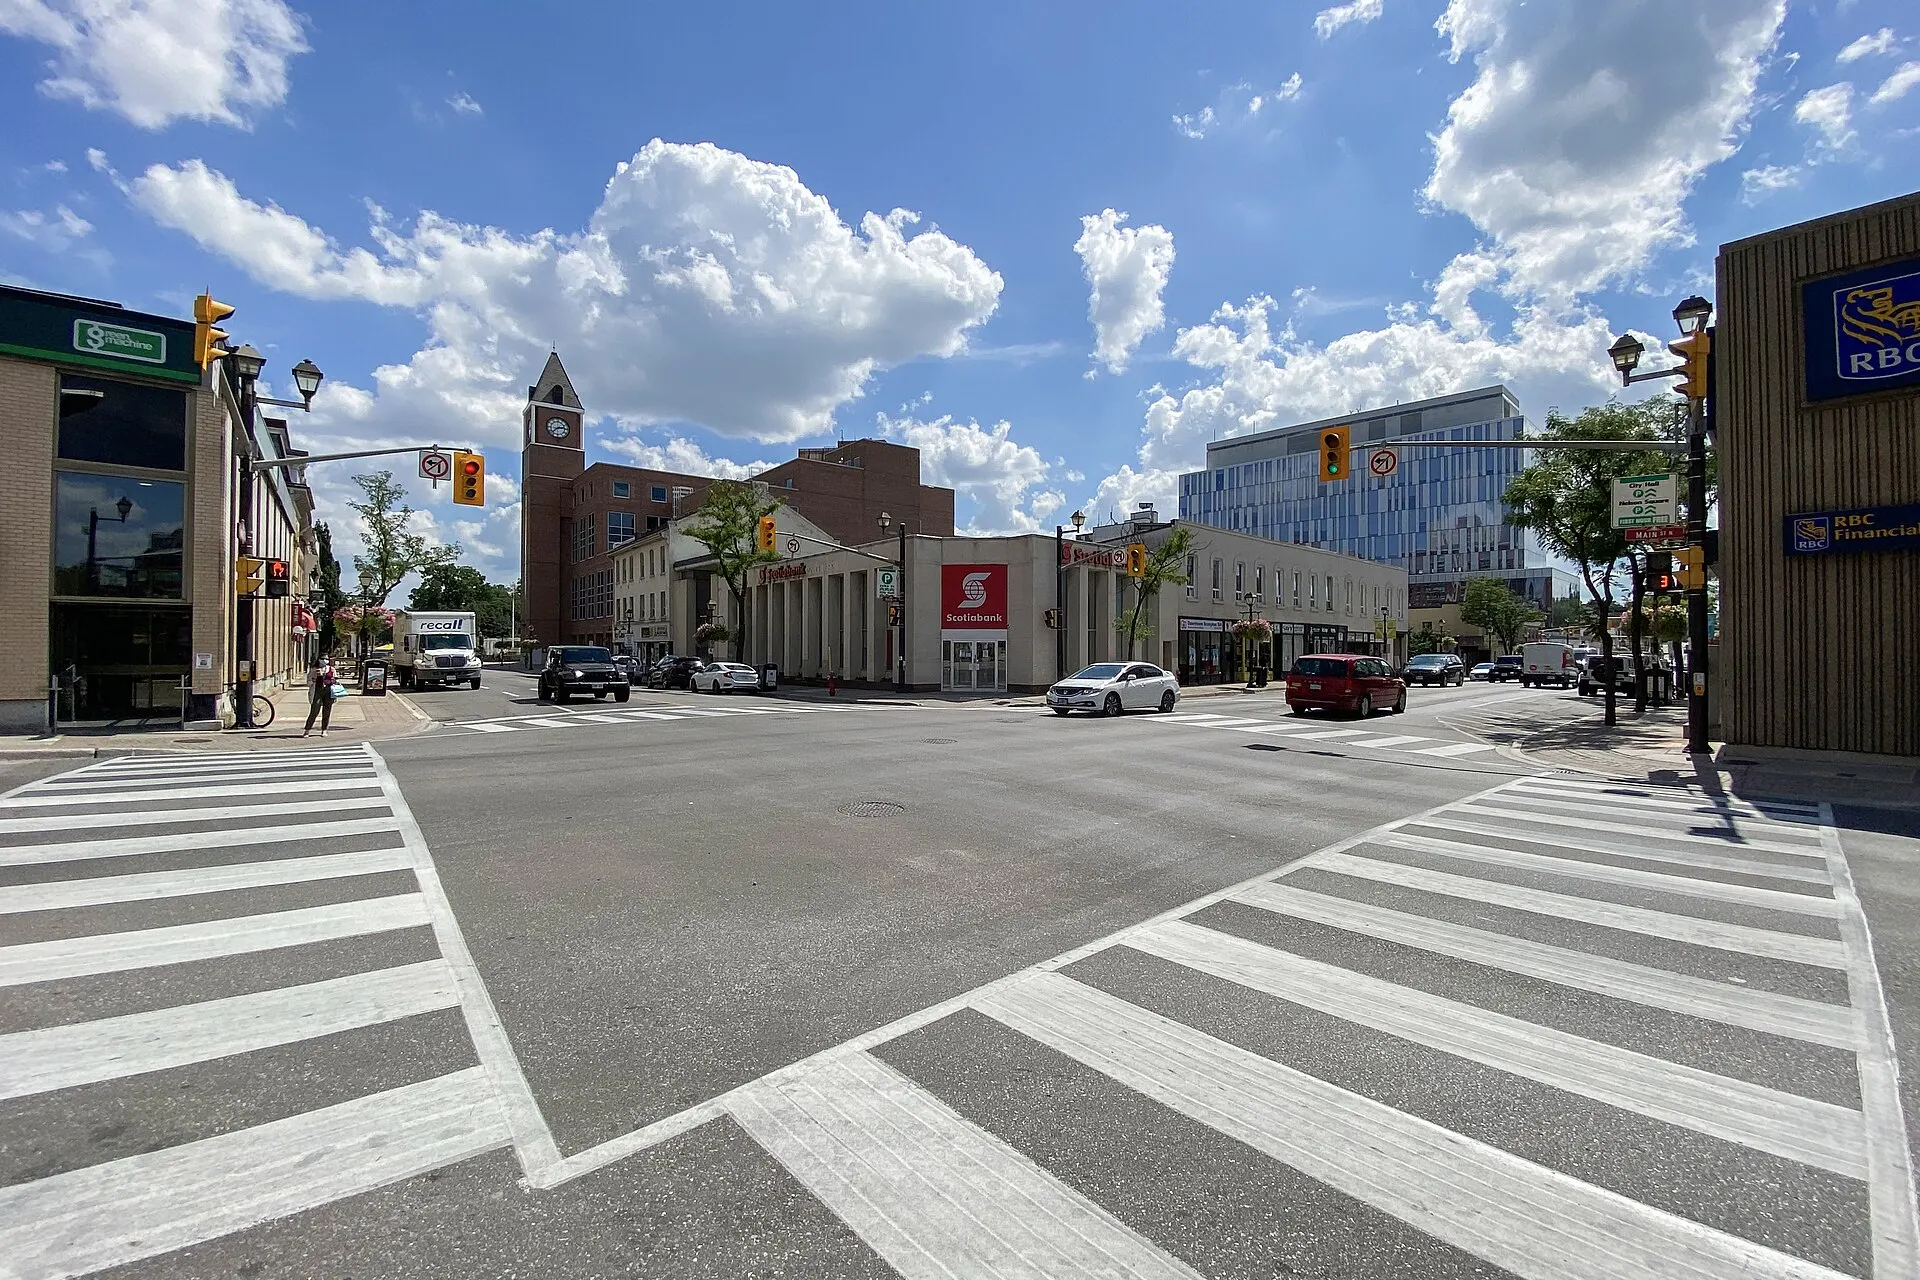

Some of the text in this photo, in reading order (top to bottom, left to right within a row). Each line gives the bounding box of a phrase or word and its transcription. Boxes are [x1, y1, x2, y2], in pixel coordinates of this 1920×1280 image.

[105, 336, 153, 351] machine
[1833, 514, 1874, 527] RBC
[1799, 540, 1825, 549] RBC
[1660, 575, 1669, 588] 3
[946, 613, 1003, 622] Scotiabank
